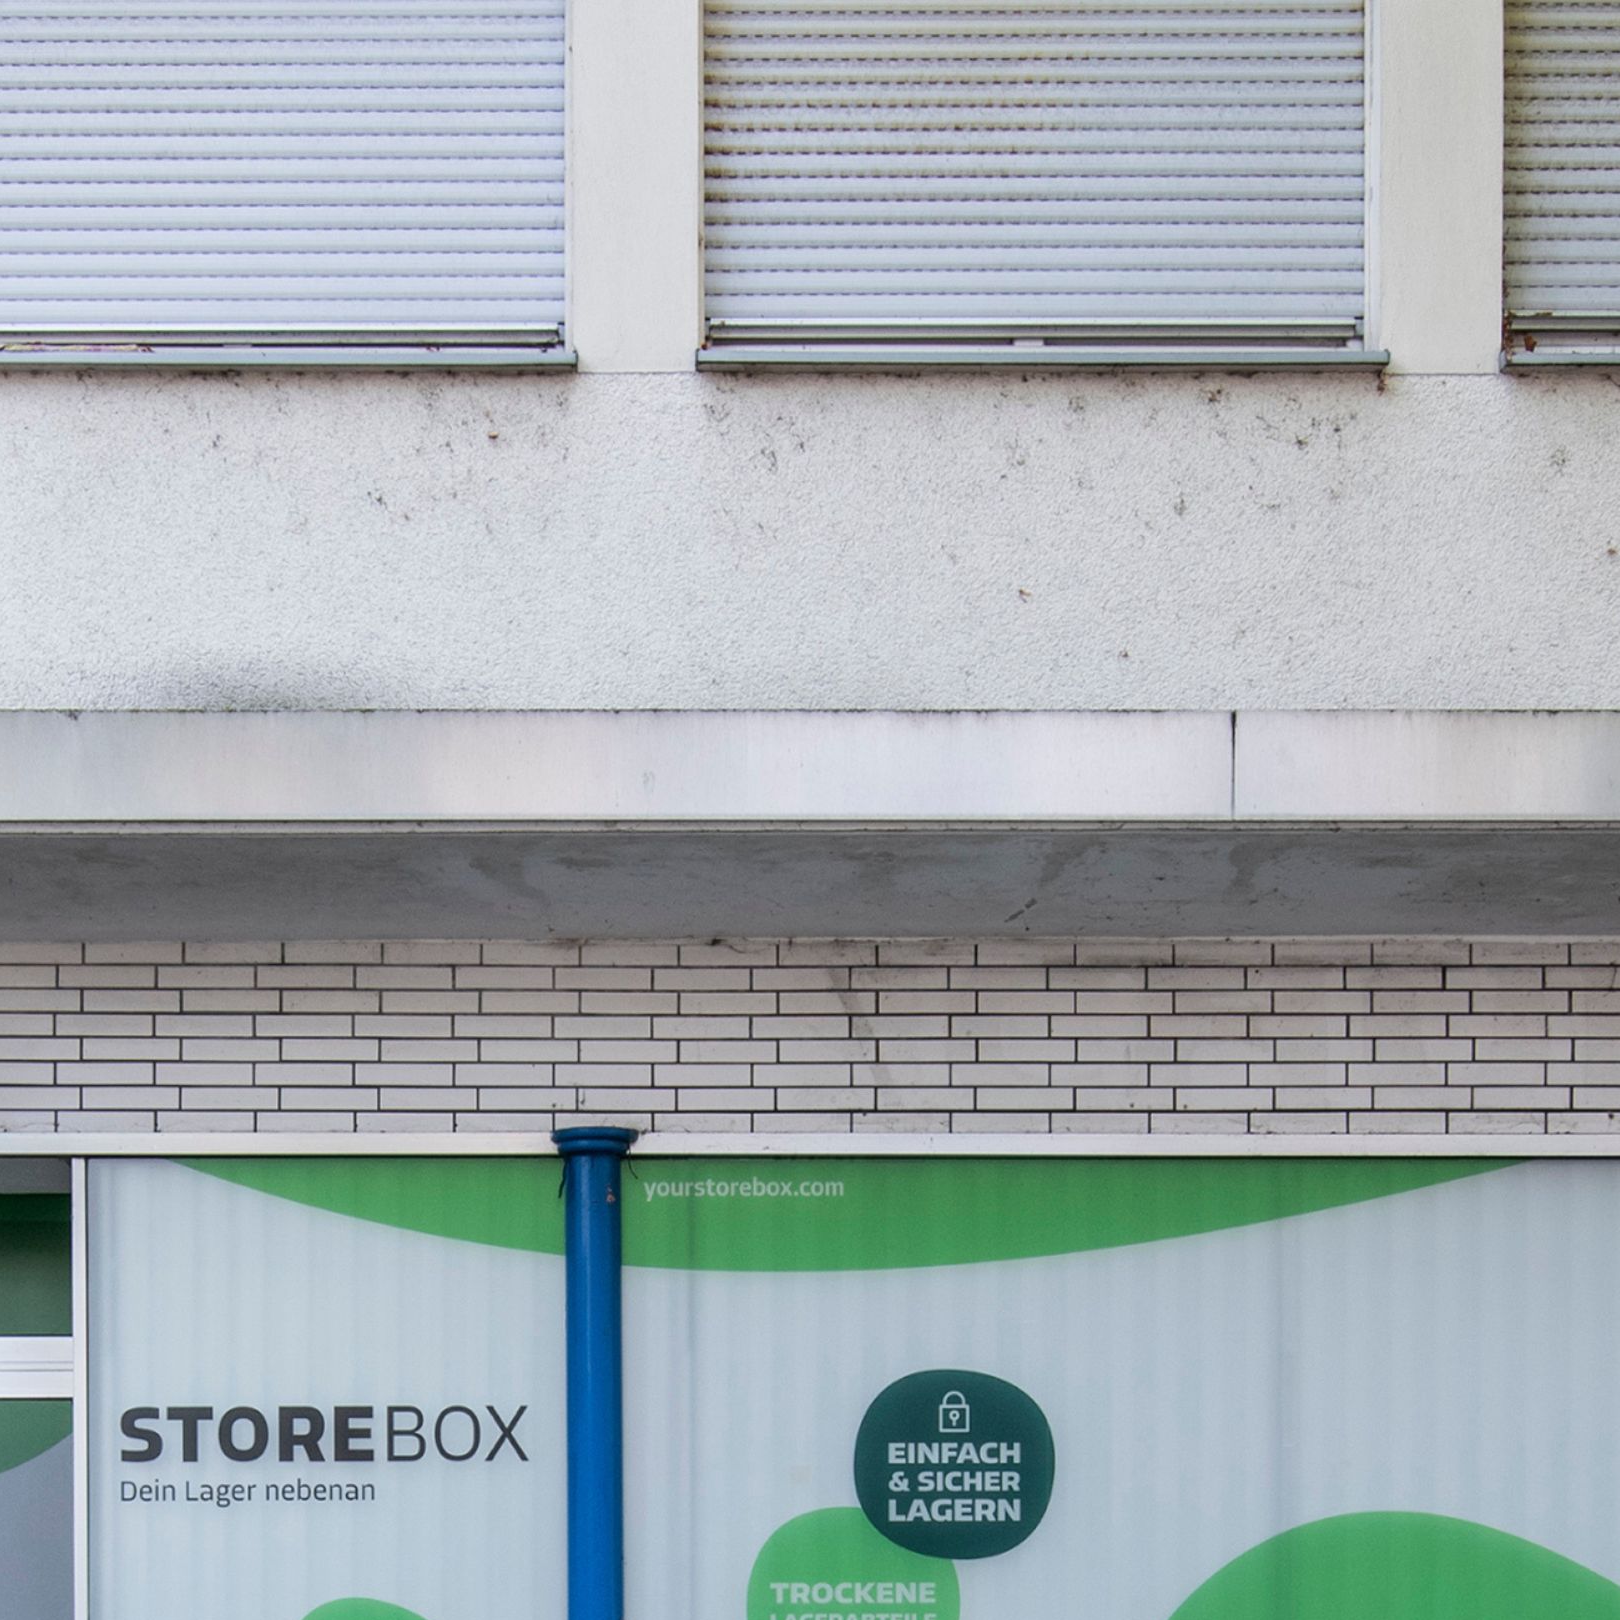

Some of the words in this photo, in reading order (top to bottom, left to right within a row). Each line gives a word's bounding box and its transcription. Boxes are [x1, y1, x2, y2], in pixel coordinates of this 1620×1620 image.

[643, 1177, 845, 1201] yourstorebox.com
[119, 1405, 530, 1463] STOREBOX
[887, 1442, 1021, 1464] EINFACH
[120, 1480, 176, 1502] Dein
[185, 1480, 257, 1507] Lager
[265, 1478, 375, 1502] nebenan
[888, 1470, 910, 1492] &
[917, 1470, 1021, 1492] SICHER
[887, 1499, 1021, 1522] LAGERN
[770, 1582, 936, 1604] TROCKENE
